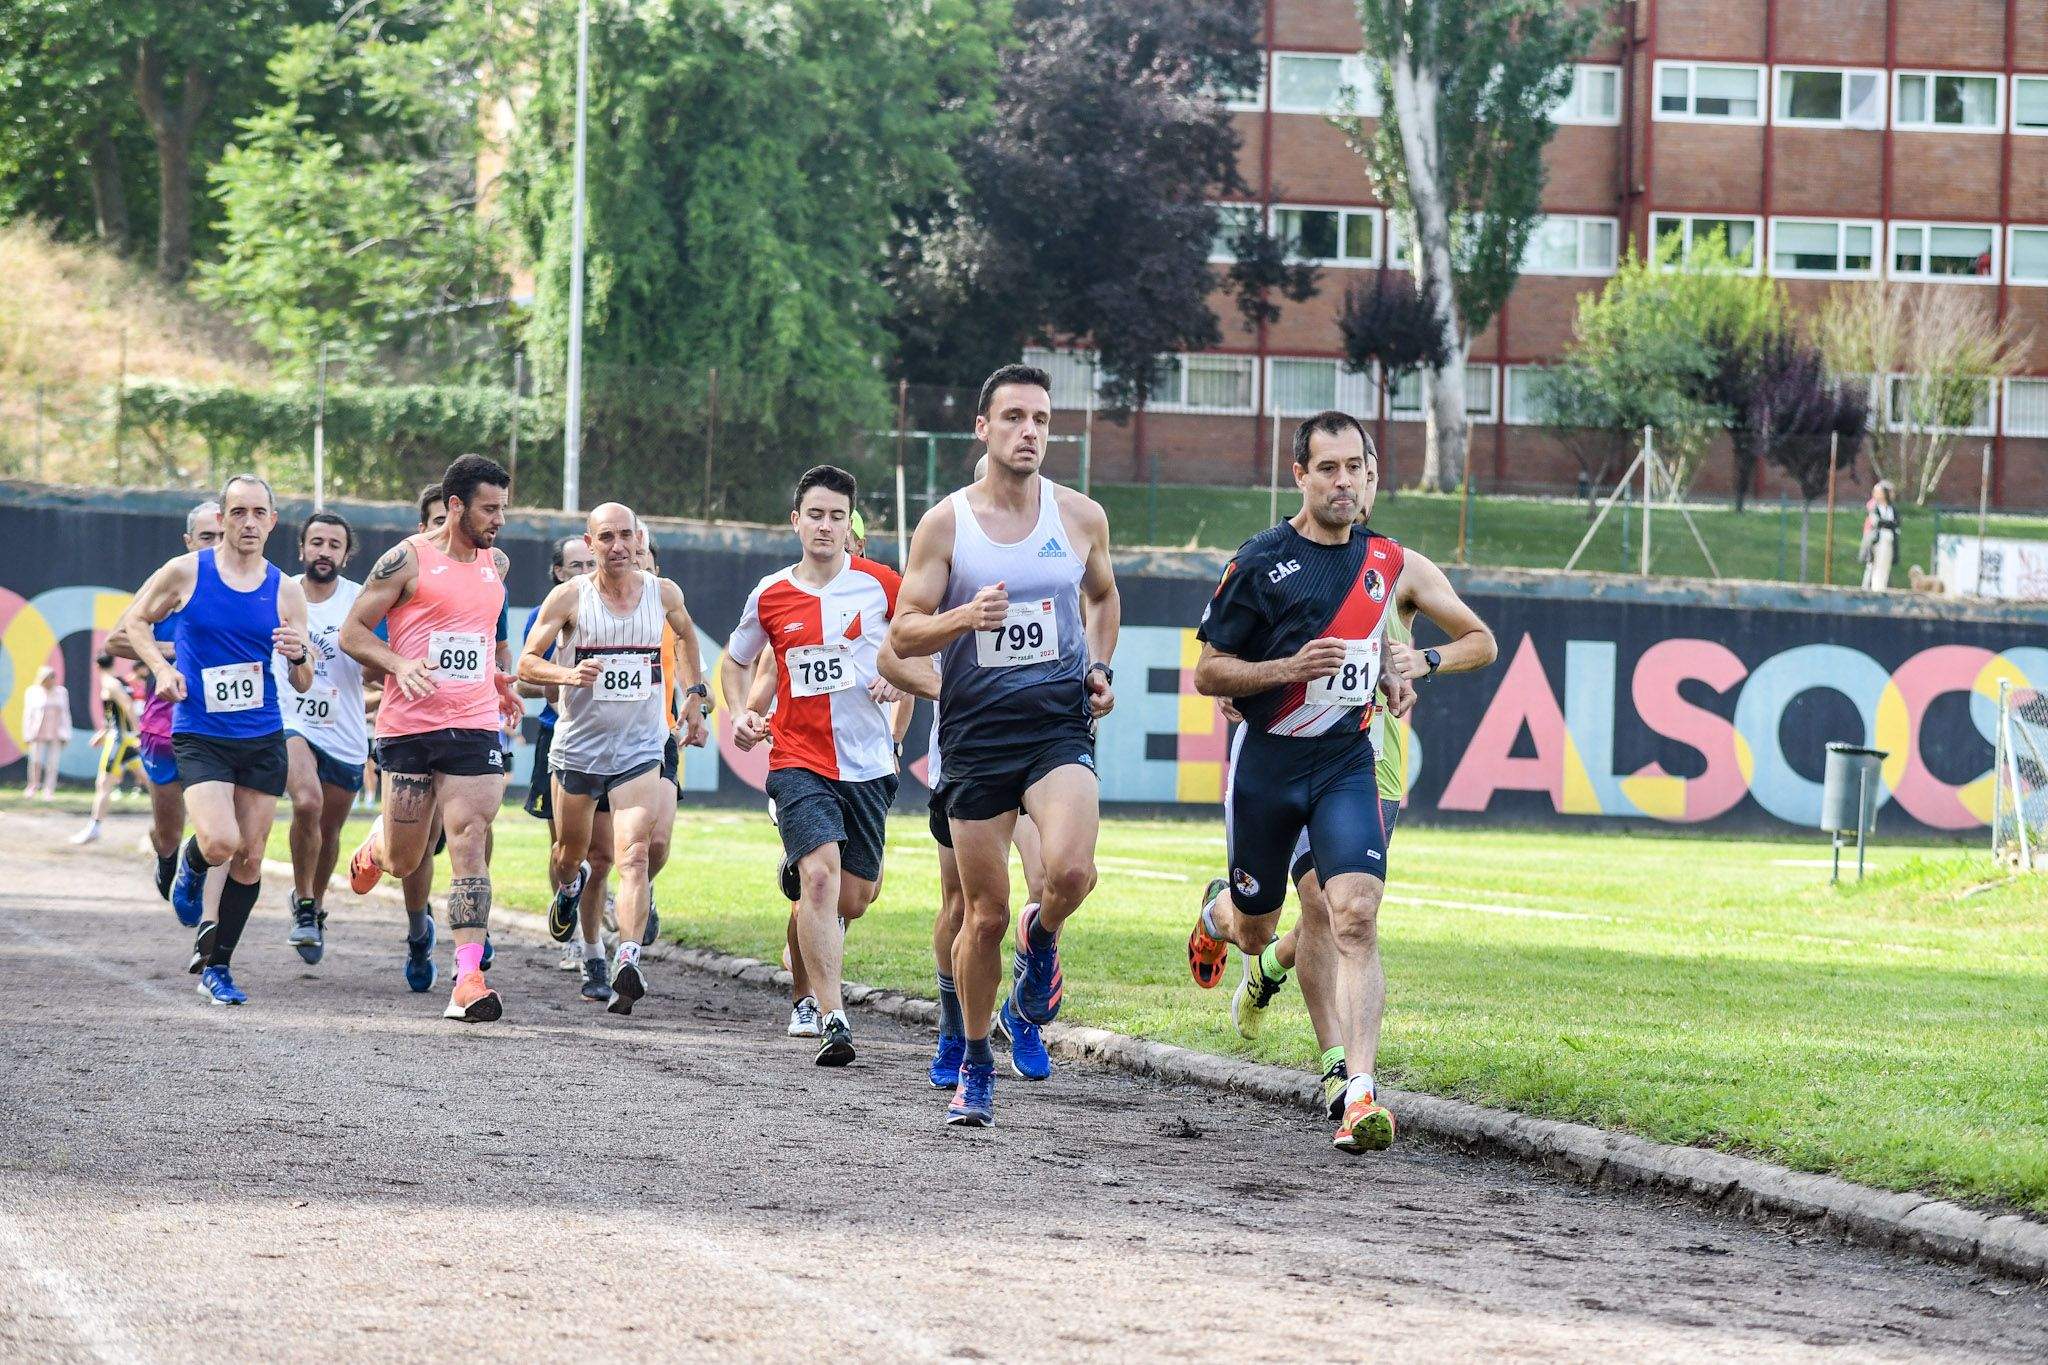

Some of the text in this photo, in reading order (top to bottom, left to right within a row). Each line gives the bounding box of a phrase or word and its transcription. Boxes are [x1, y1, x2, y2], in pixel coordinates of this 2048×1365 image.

[1037, 550, 1067, 558] adidas
[990, 622, 1043, 652] 799
[440, 649, 478, 671] 698
[1039, 649, 1055, 657] 2023
[604, 670, 642, 690] 884
[799, 657, 843, 685] 785
[216, 679, 254, 701] 819
[296, 697, 329, 718] 730
